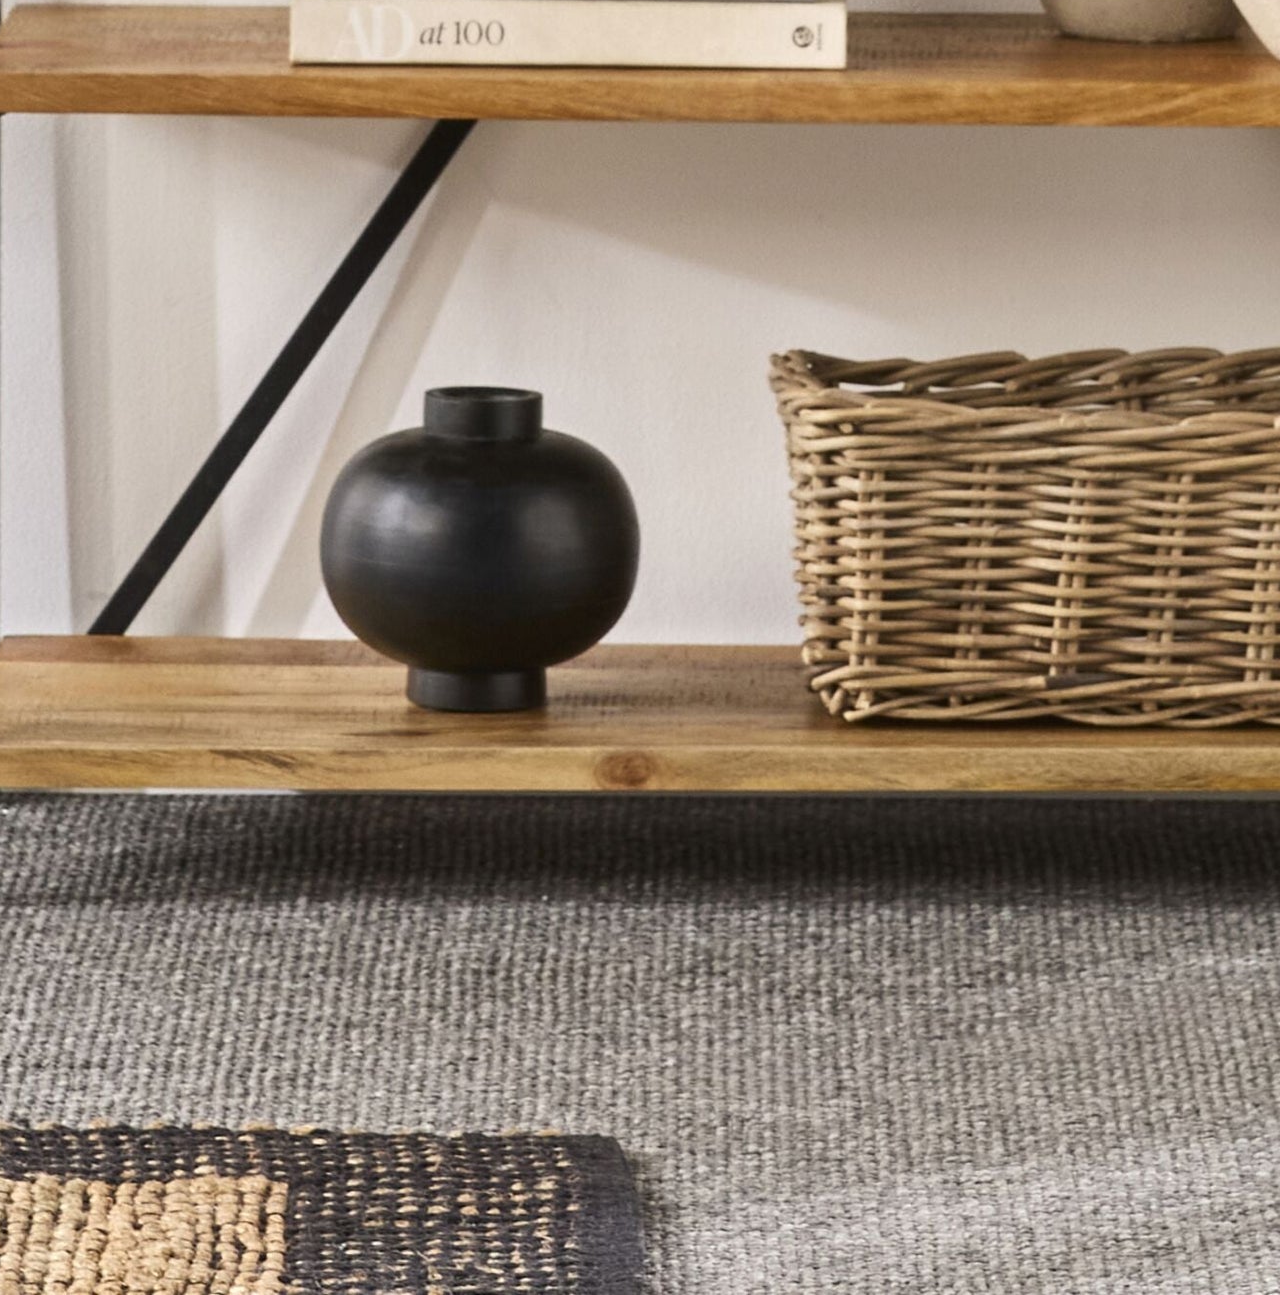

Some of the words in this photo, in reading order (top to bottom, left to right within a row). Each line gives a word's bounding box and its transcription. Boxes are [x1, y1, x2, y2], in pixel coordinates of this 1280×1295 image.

[333, 3, 416, 61] AD
[419, 21, 446, 46] at
[453, 19, 506, 47] 100
